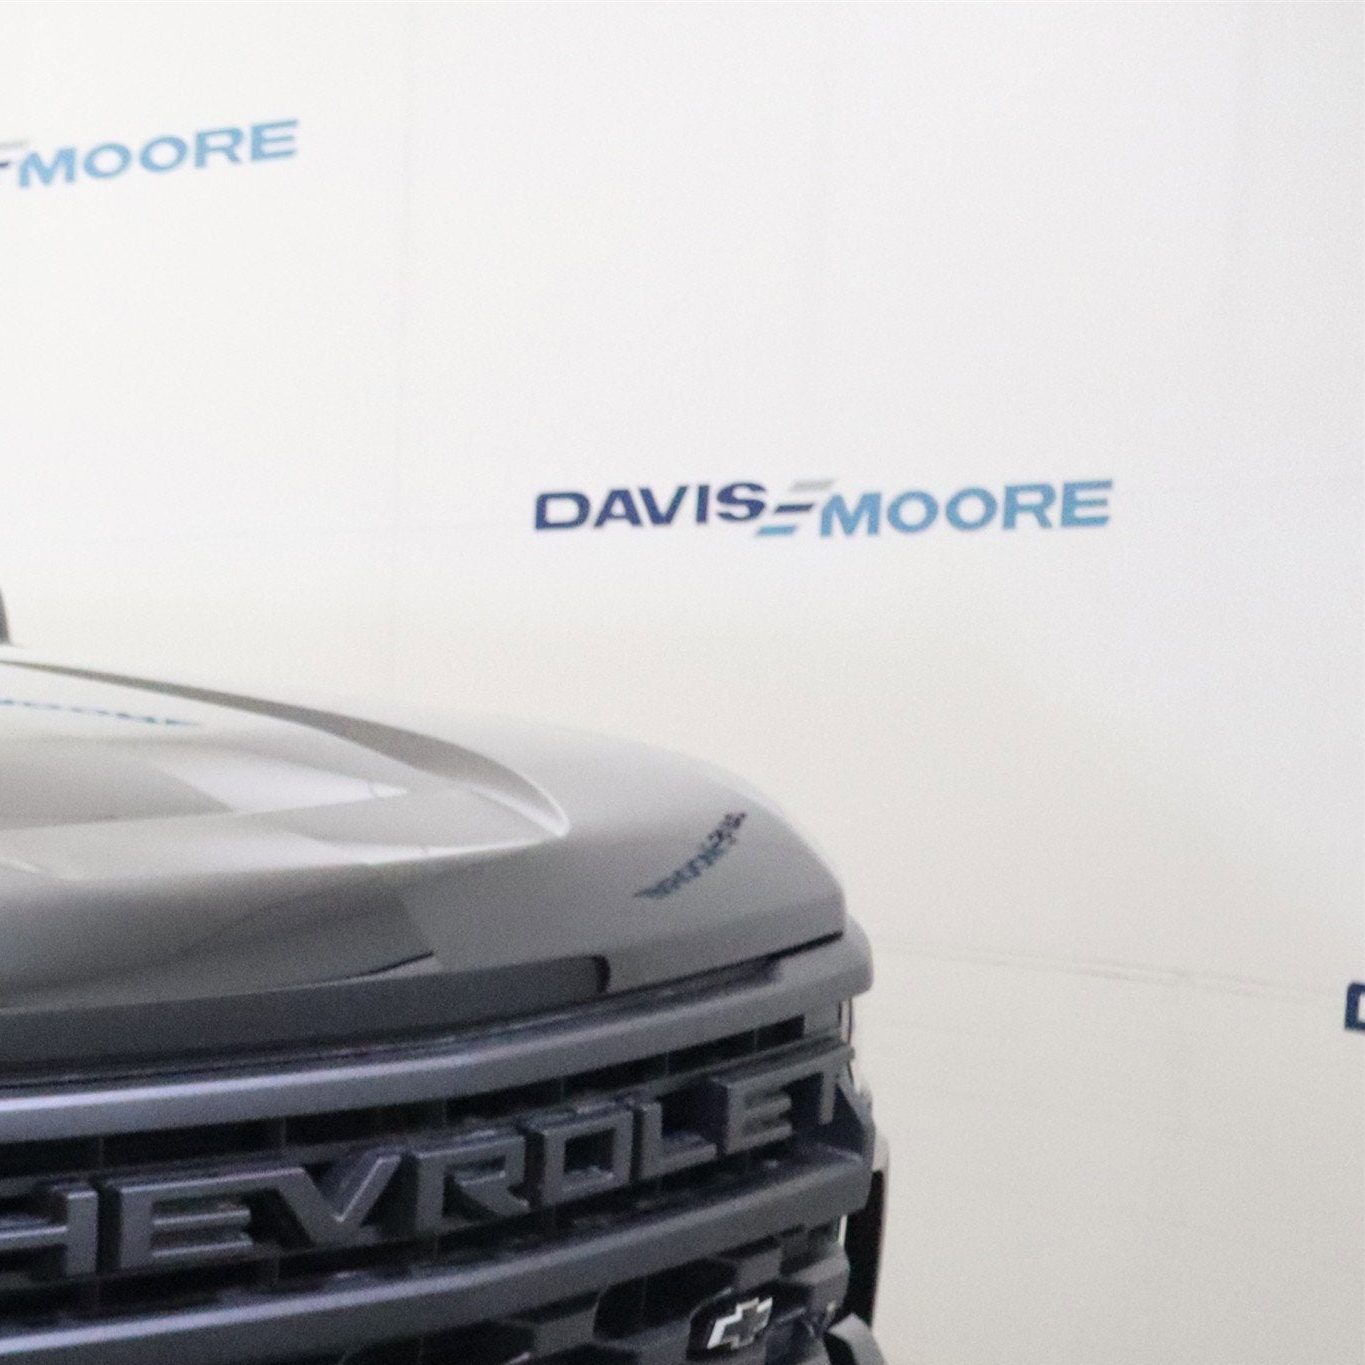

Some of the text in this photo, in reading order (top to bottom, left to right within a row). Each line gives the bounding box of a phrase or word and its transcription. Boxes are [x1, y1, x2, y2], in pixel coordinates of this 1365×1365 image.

[18, 119, 298, 188] MOORE
[534, 479, 1113, 537] DAVIS MOORE
